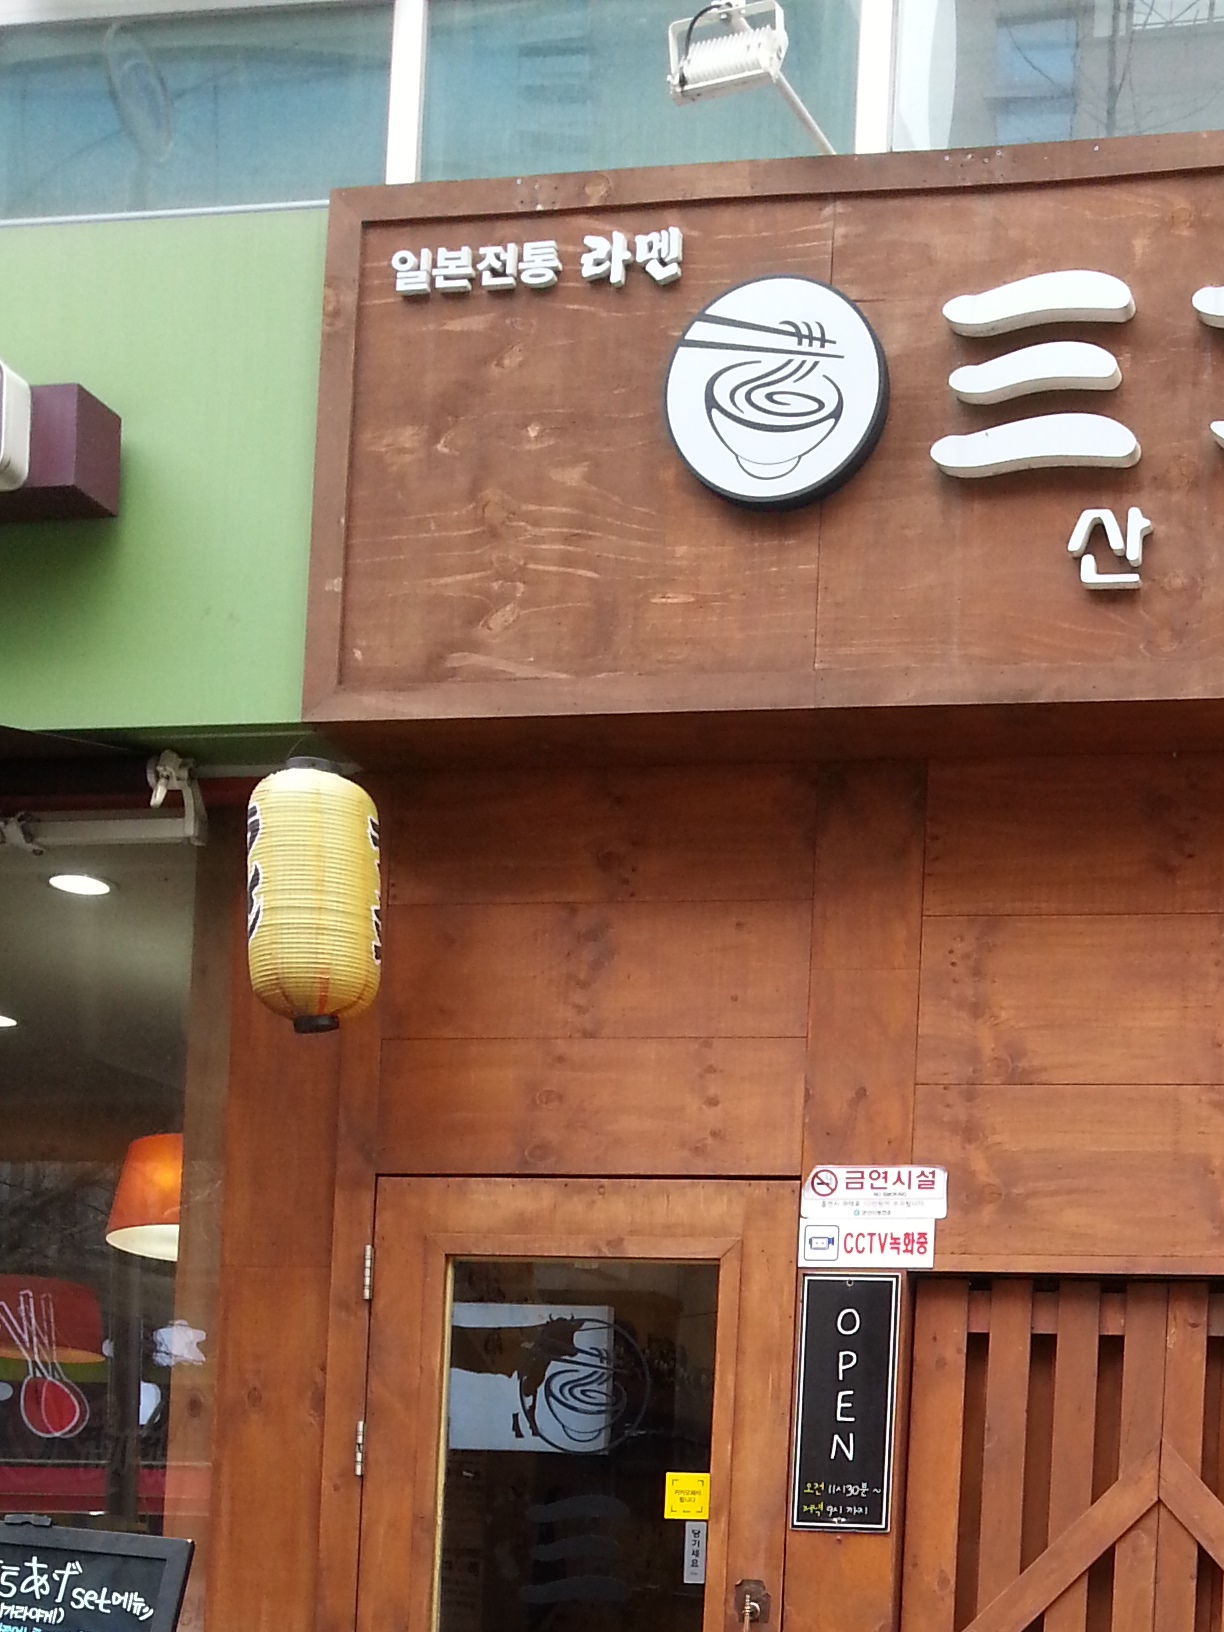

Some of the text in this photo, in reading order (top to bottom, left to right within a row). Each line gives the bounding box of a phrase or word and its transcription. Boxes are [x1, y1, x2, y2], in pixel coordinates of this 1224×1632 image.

[390, 226, 684, 299] 일본전통 라멘
[844, 1169, 937, 1191] 금연시설
[843, 1231, 928, 1256] CCTV녹화중
